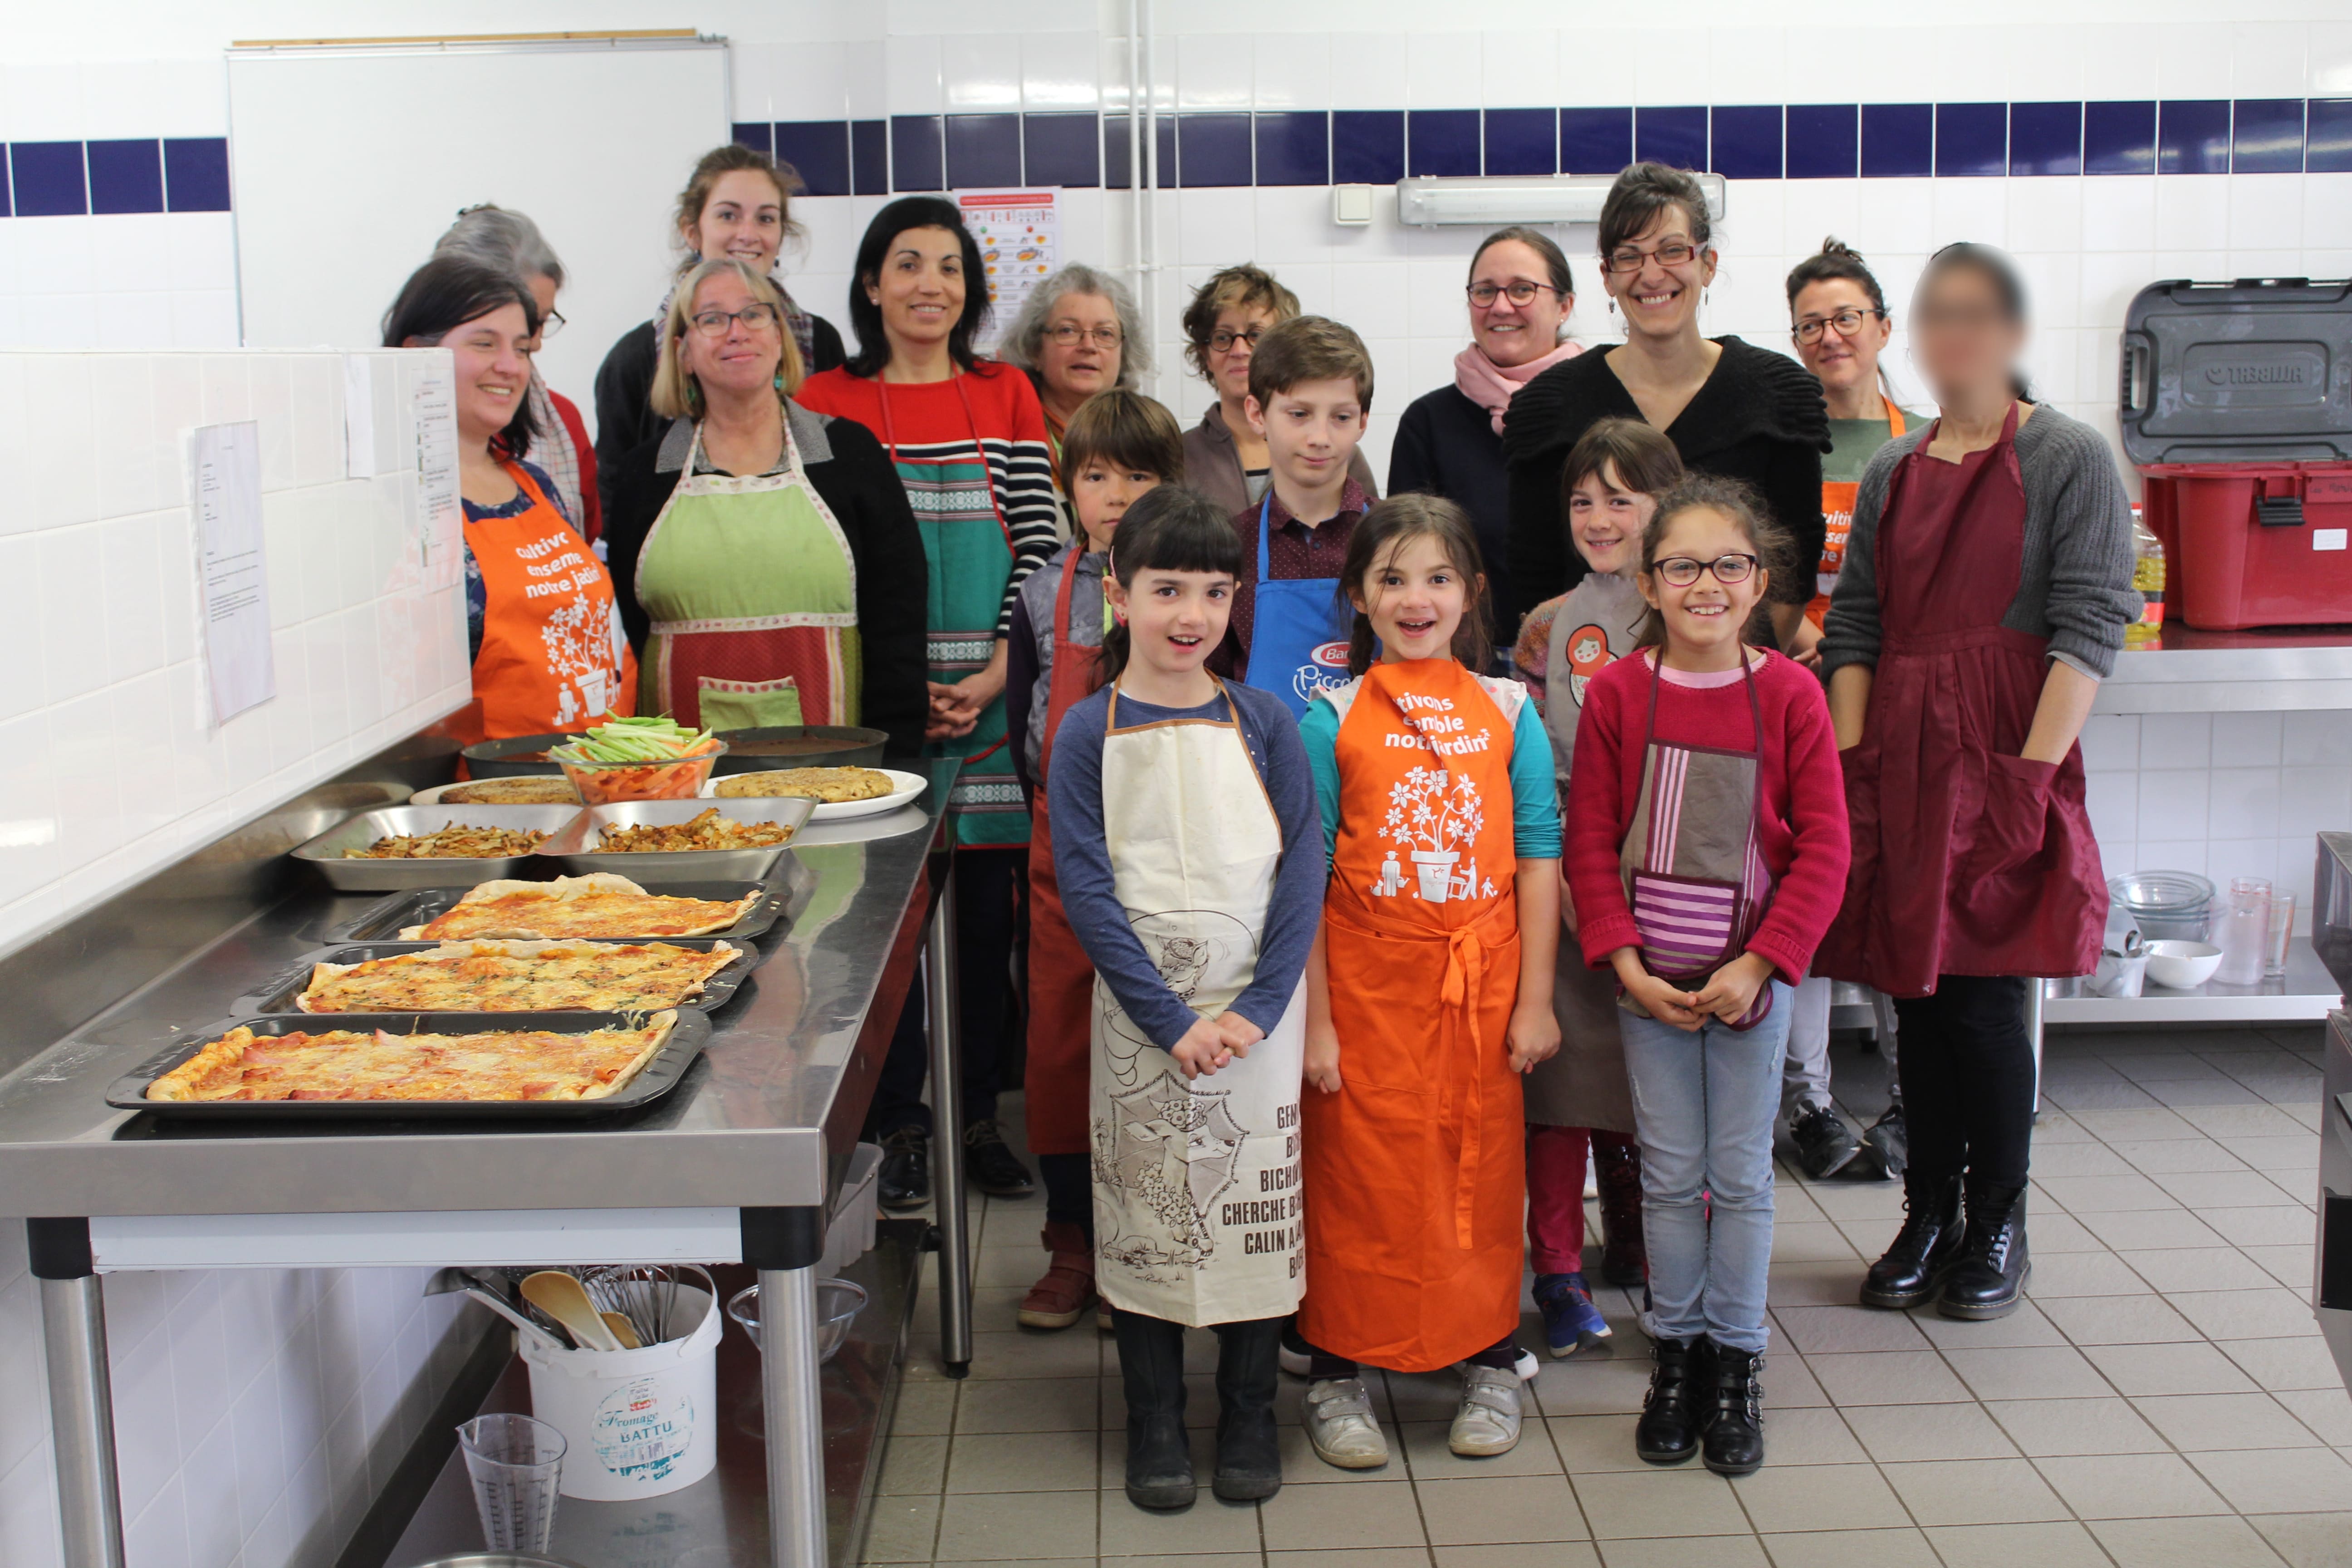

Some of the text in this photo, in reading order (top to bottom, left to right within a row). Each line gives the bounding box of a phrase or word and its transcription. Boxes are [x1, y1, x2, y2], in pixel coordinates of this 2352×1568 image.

[525, 579, 572, 598] notre
[1223, 1198, 1285, 1225] CHERCHE
[1245, 1229, 1285, 1254] CALIN
[620, 1421, 672, 1443] BATTU
